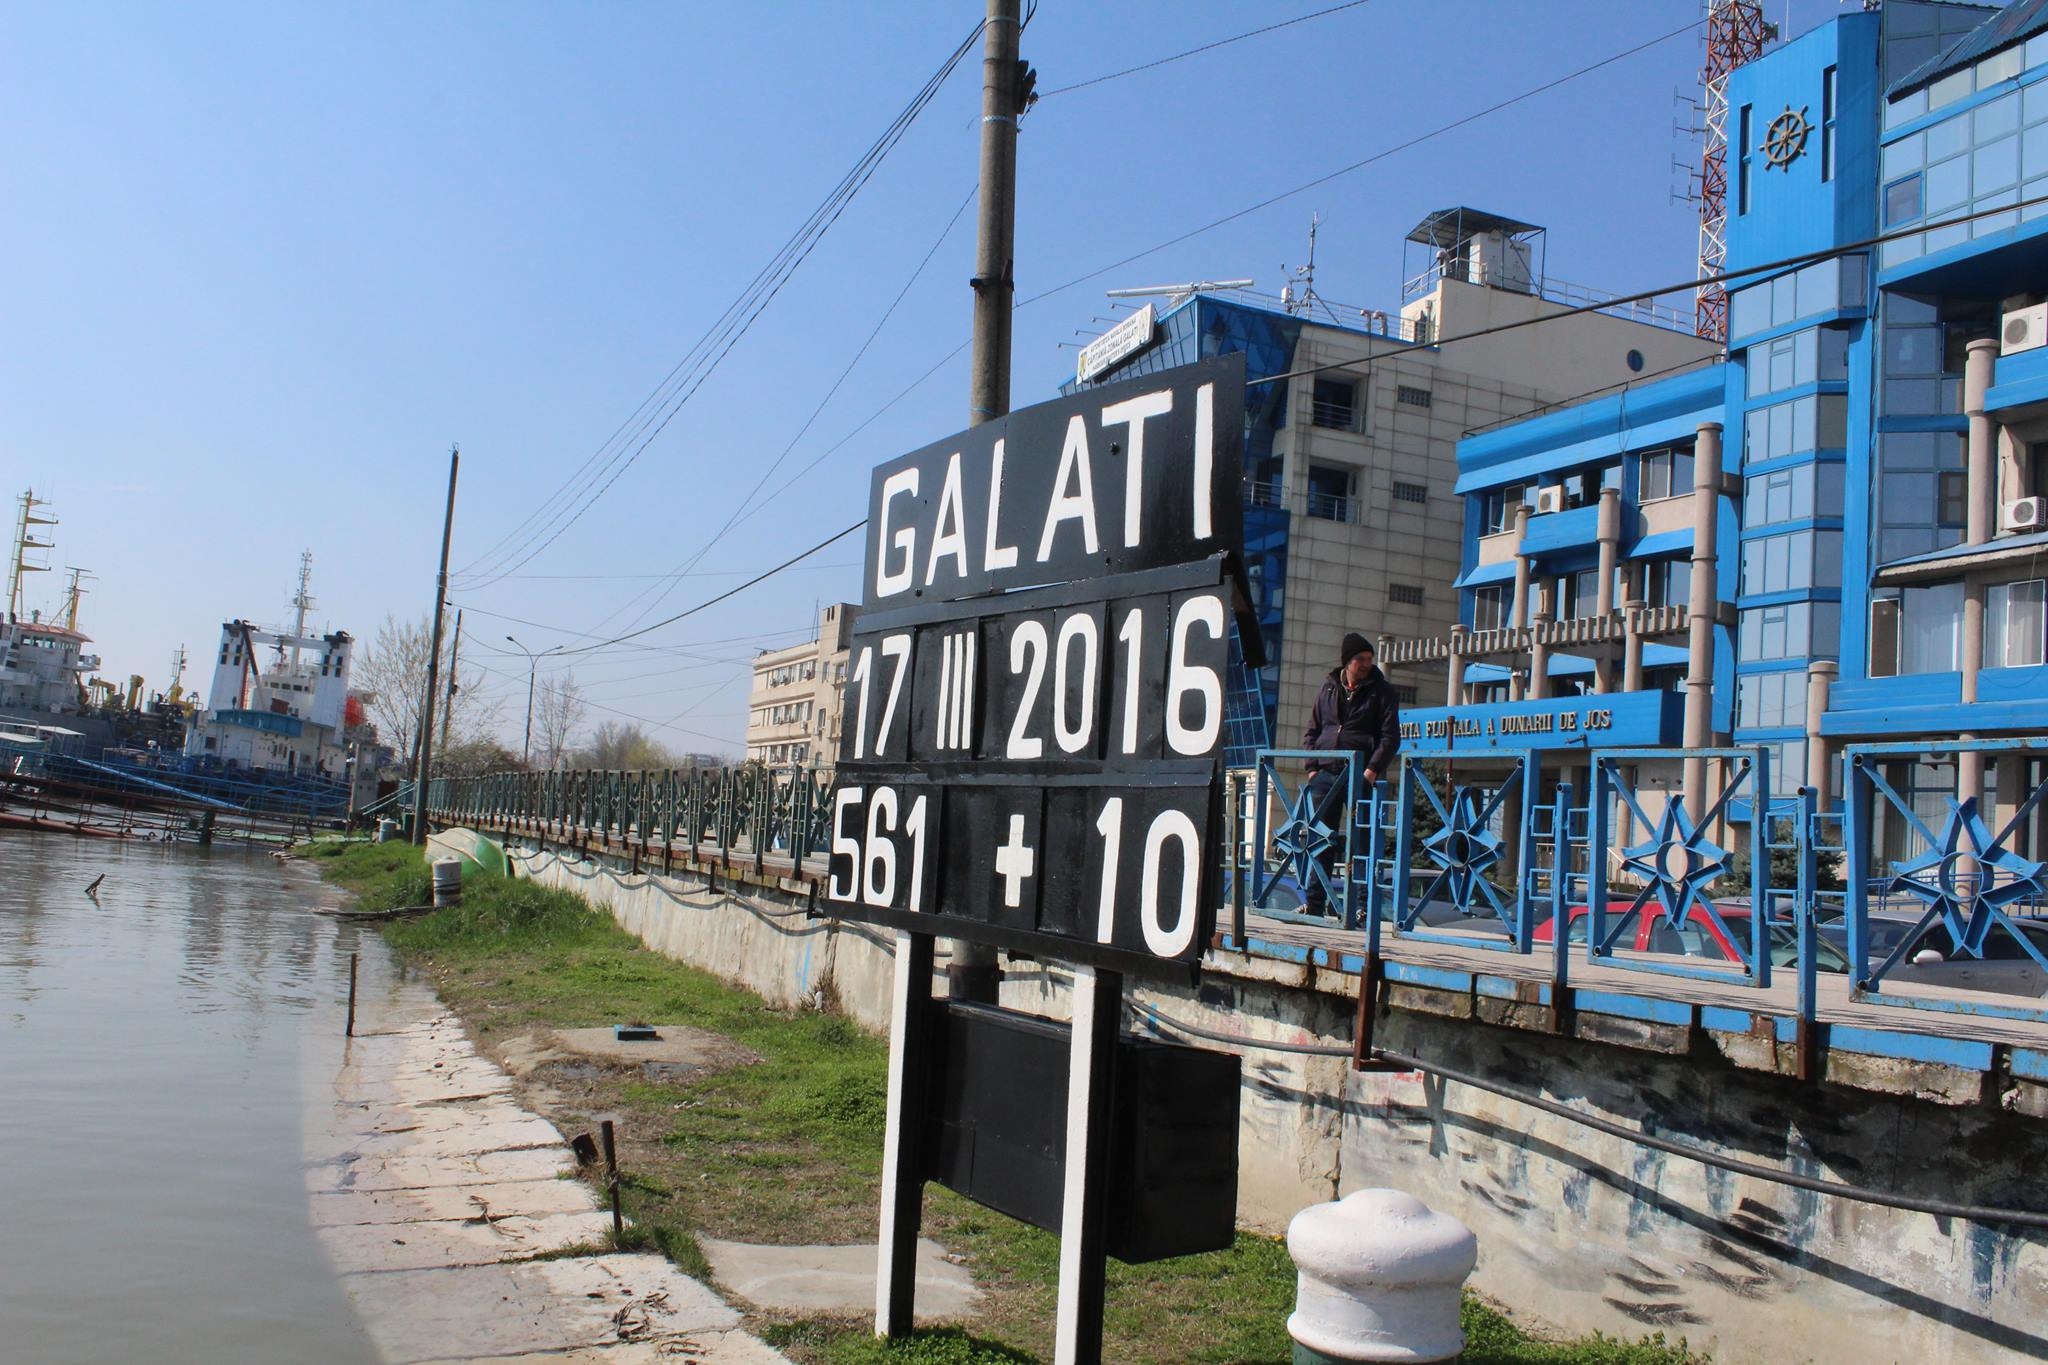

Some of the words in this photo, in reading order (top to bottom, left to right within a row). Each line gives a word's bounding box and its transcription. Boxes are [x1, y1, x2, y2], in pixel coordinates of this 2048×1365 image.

[877, 384, 1214, 598] GALATI
[853, 634, 912, 760] 17
[936, 631, 975, 750] III
[1006, 595, 1224, 760] 2016
[1425, 719, 1481, 737] FLUIALA
[1486, 718, 1496, 734] A
[1500, 712, 1553, 734] DUNARII
[1559, 711, 1578, 731] DE
[1583, 709, 1612, 729] JOS
[829, 786, 927, 913] 561
[1097, 797, 1200, 958] 10
